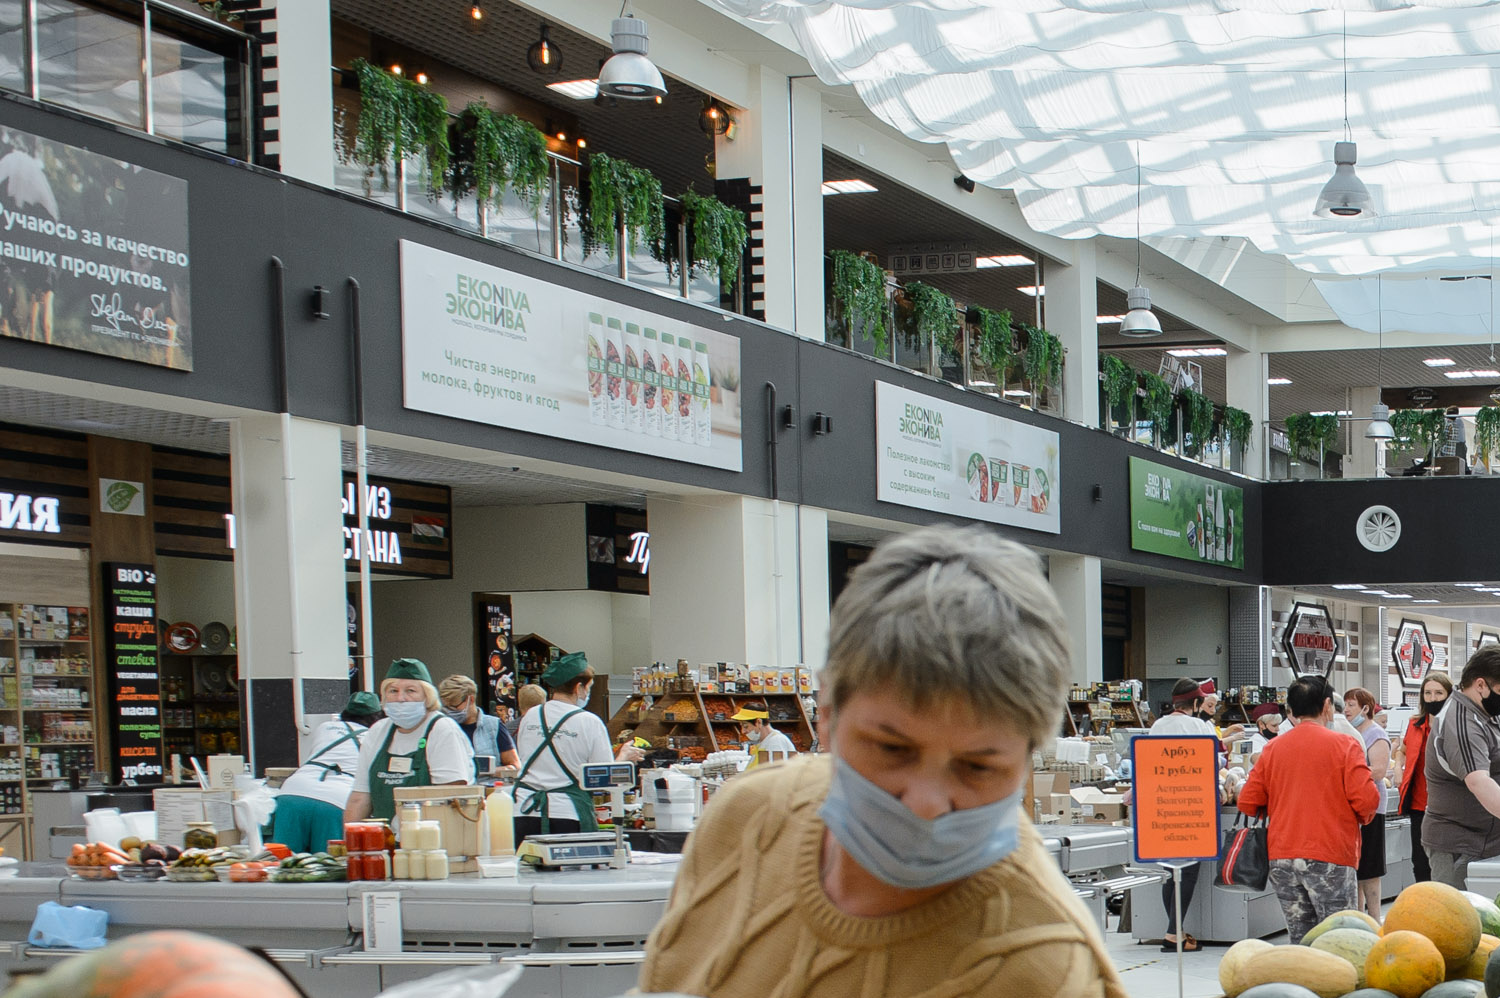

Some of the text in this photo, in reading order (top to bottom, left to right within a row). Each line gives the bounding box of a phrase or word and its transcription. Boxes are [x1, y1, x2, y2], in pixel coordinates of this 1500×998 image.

[0, 202, 190, 268] учаюсь за качество
[61, 255, 168, 292] продуктов.
[456, 273, 532, 314] EKONIVA
[445, 292, 527, 333] ЭКОНИВА
[444, 349, 537, 385] Чистая энергия
[421, 370, 561, 412] молока, фруктов и ягод
[904, 403, 943, 428] EKONIVA
[899, 417, 942, 442] ЭКОНИВА
[887, 446, 919, 465] Полезное
[919, 457, 951, 472] лакомство
[908, 470, 936, 483] высоким
[889, 480, 951, 500] содержанием белка
[117, 568, 144, 583] BiO
[116, 606, 153, 618] каши
[116, 653, 156, 666] стевия
[120, 706, 158, 717] масла
[1161, 746, 1197, 759] Арбуз
[121, 762, 162, 779] урбеч
[1153, 765, 1202, 777] 12 руб./кг
[1156, 785, 1203, 794] Астрахань
[1156, 796, 1204, 807] Волгоград
[1156, 808, 1205, 819] Краснодар
[1151, 821, 1210, 830] Воронежская
[1164, 832, 1199, 842] область
